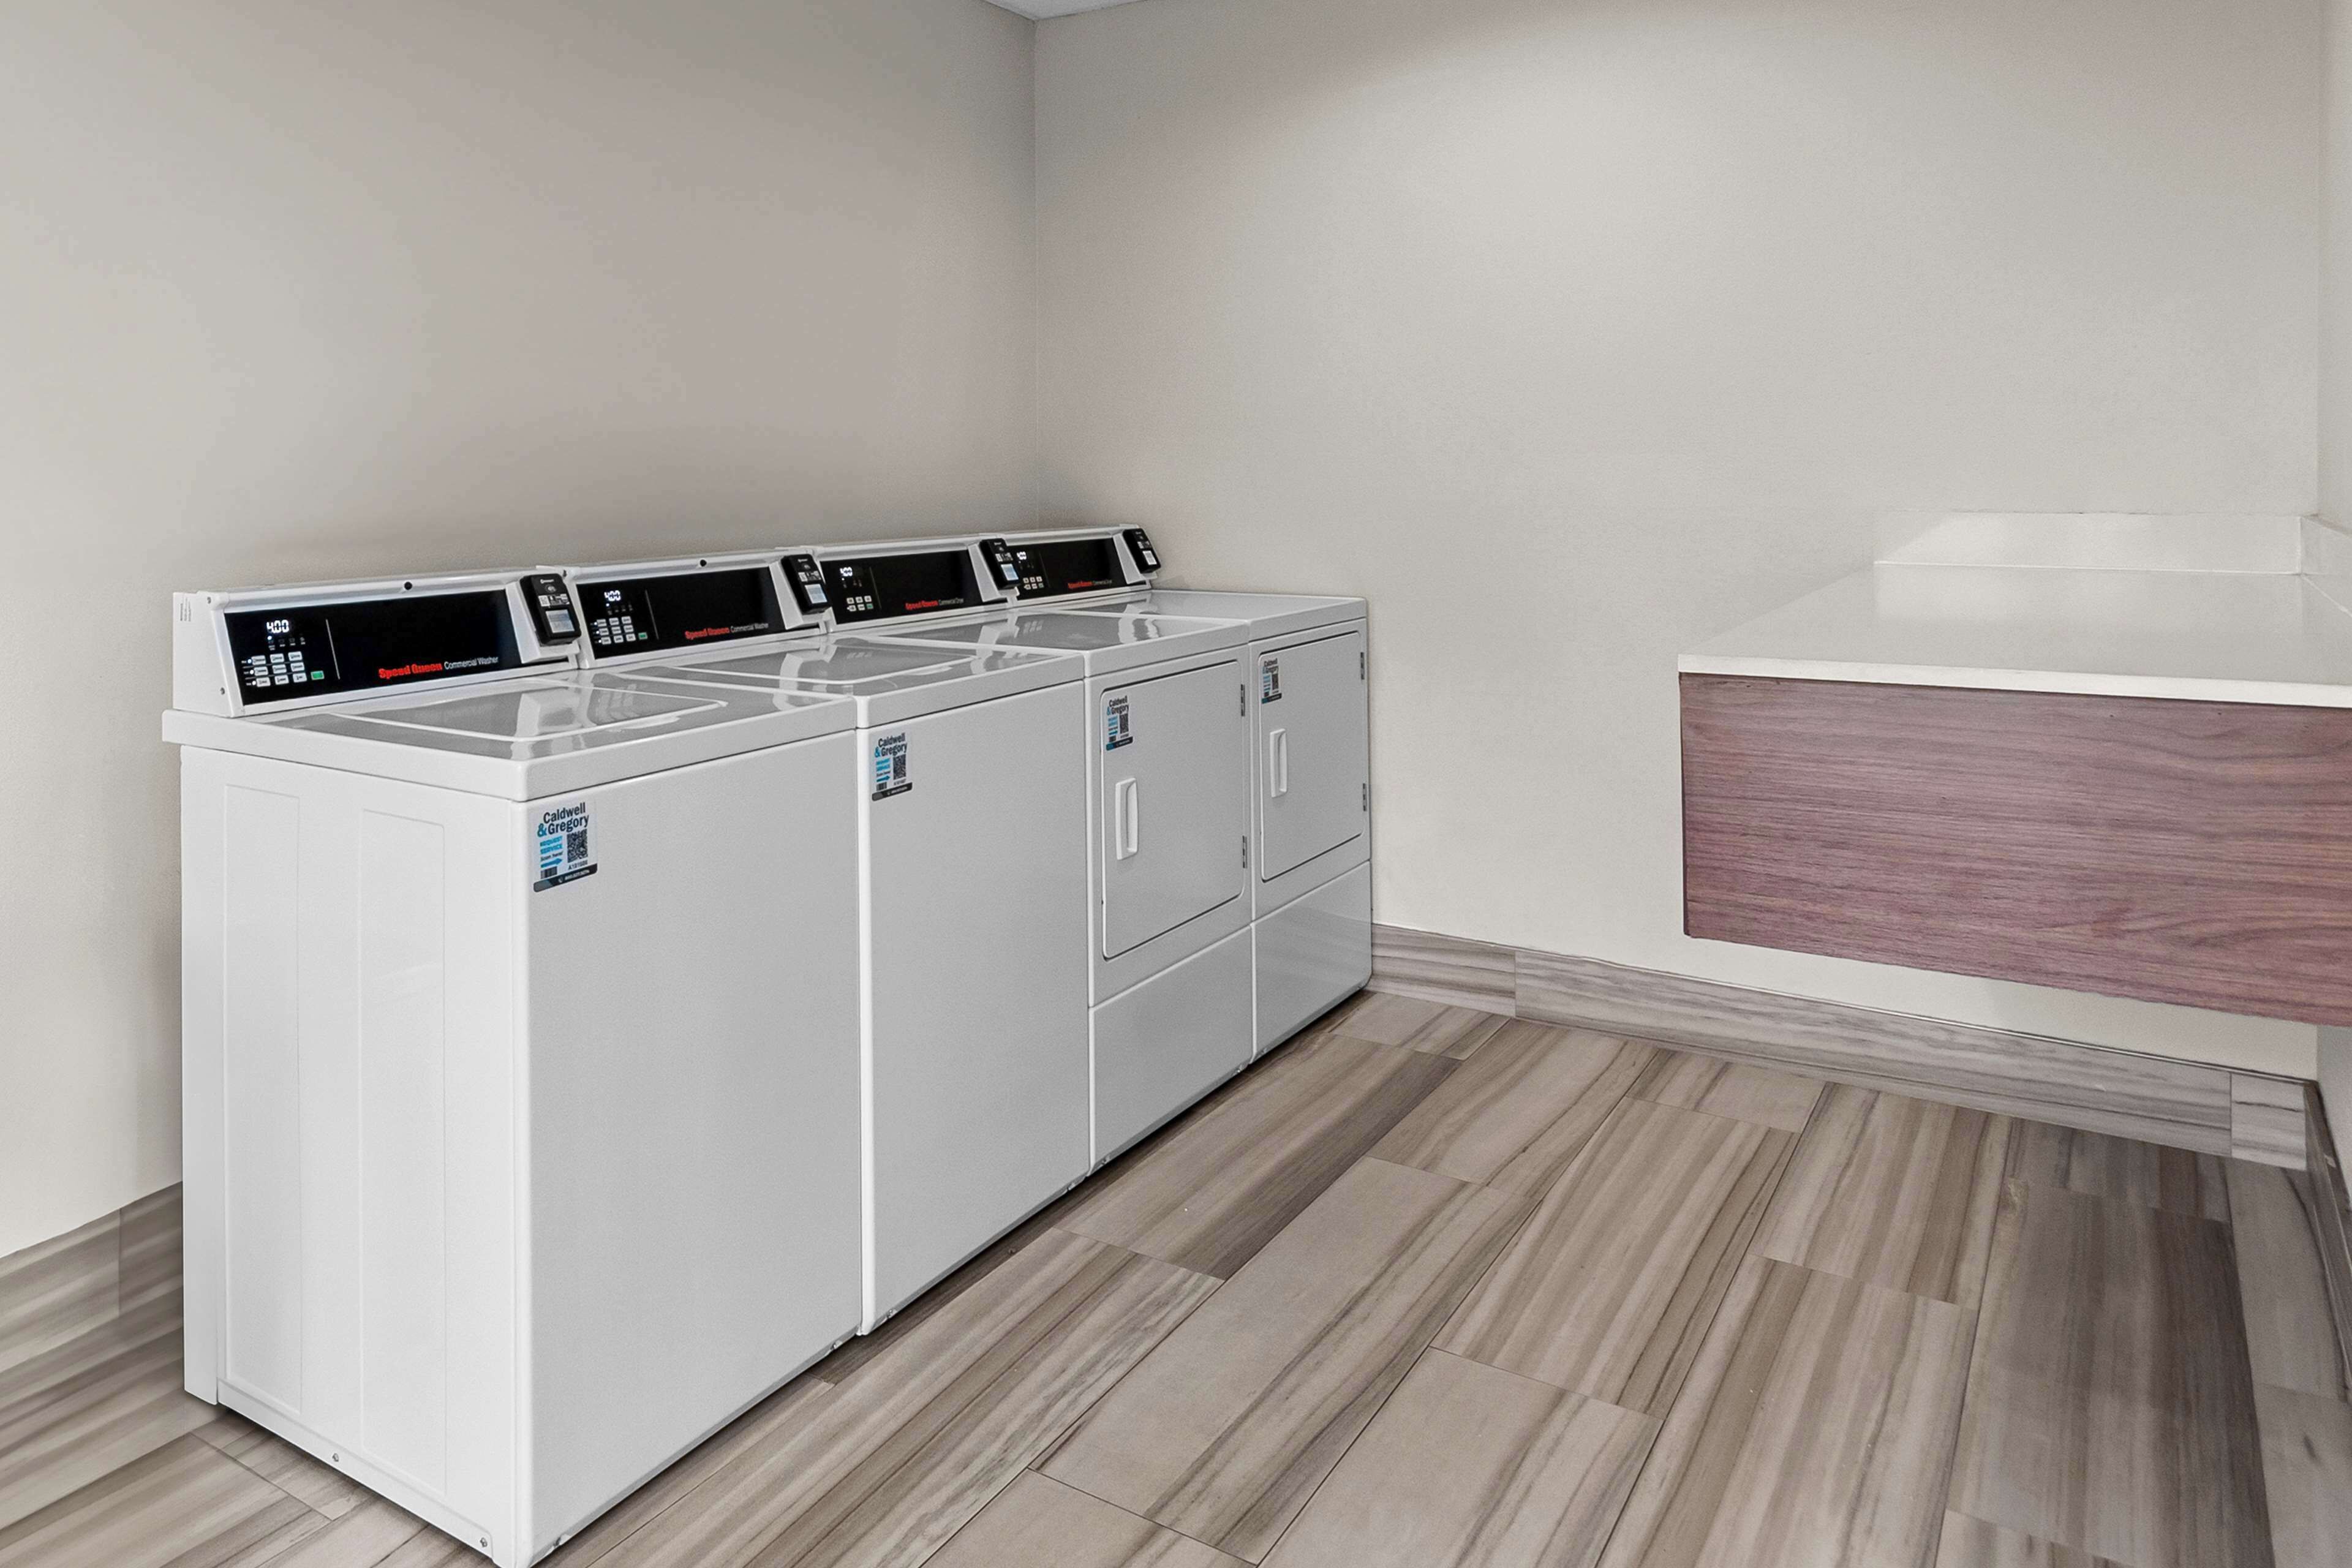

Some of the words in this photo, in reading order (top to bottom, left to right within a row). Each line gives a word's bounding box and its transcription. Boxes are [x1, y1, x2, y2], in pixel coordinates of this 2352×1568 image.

[379, 665, 411, 679] Speed
[412, 663, 443, 674] Queen
[443, 658, 477, 669] Commercial
[477, 656, 499, 666] Washer
[878, 733, 905, 747] Caldwell
[543, 802, 586, 824] Caldwell
